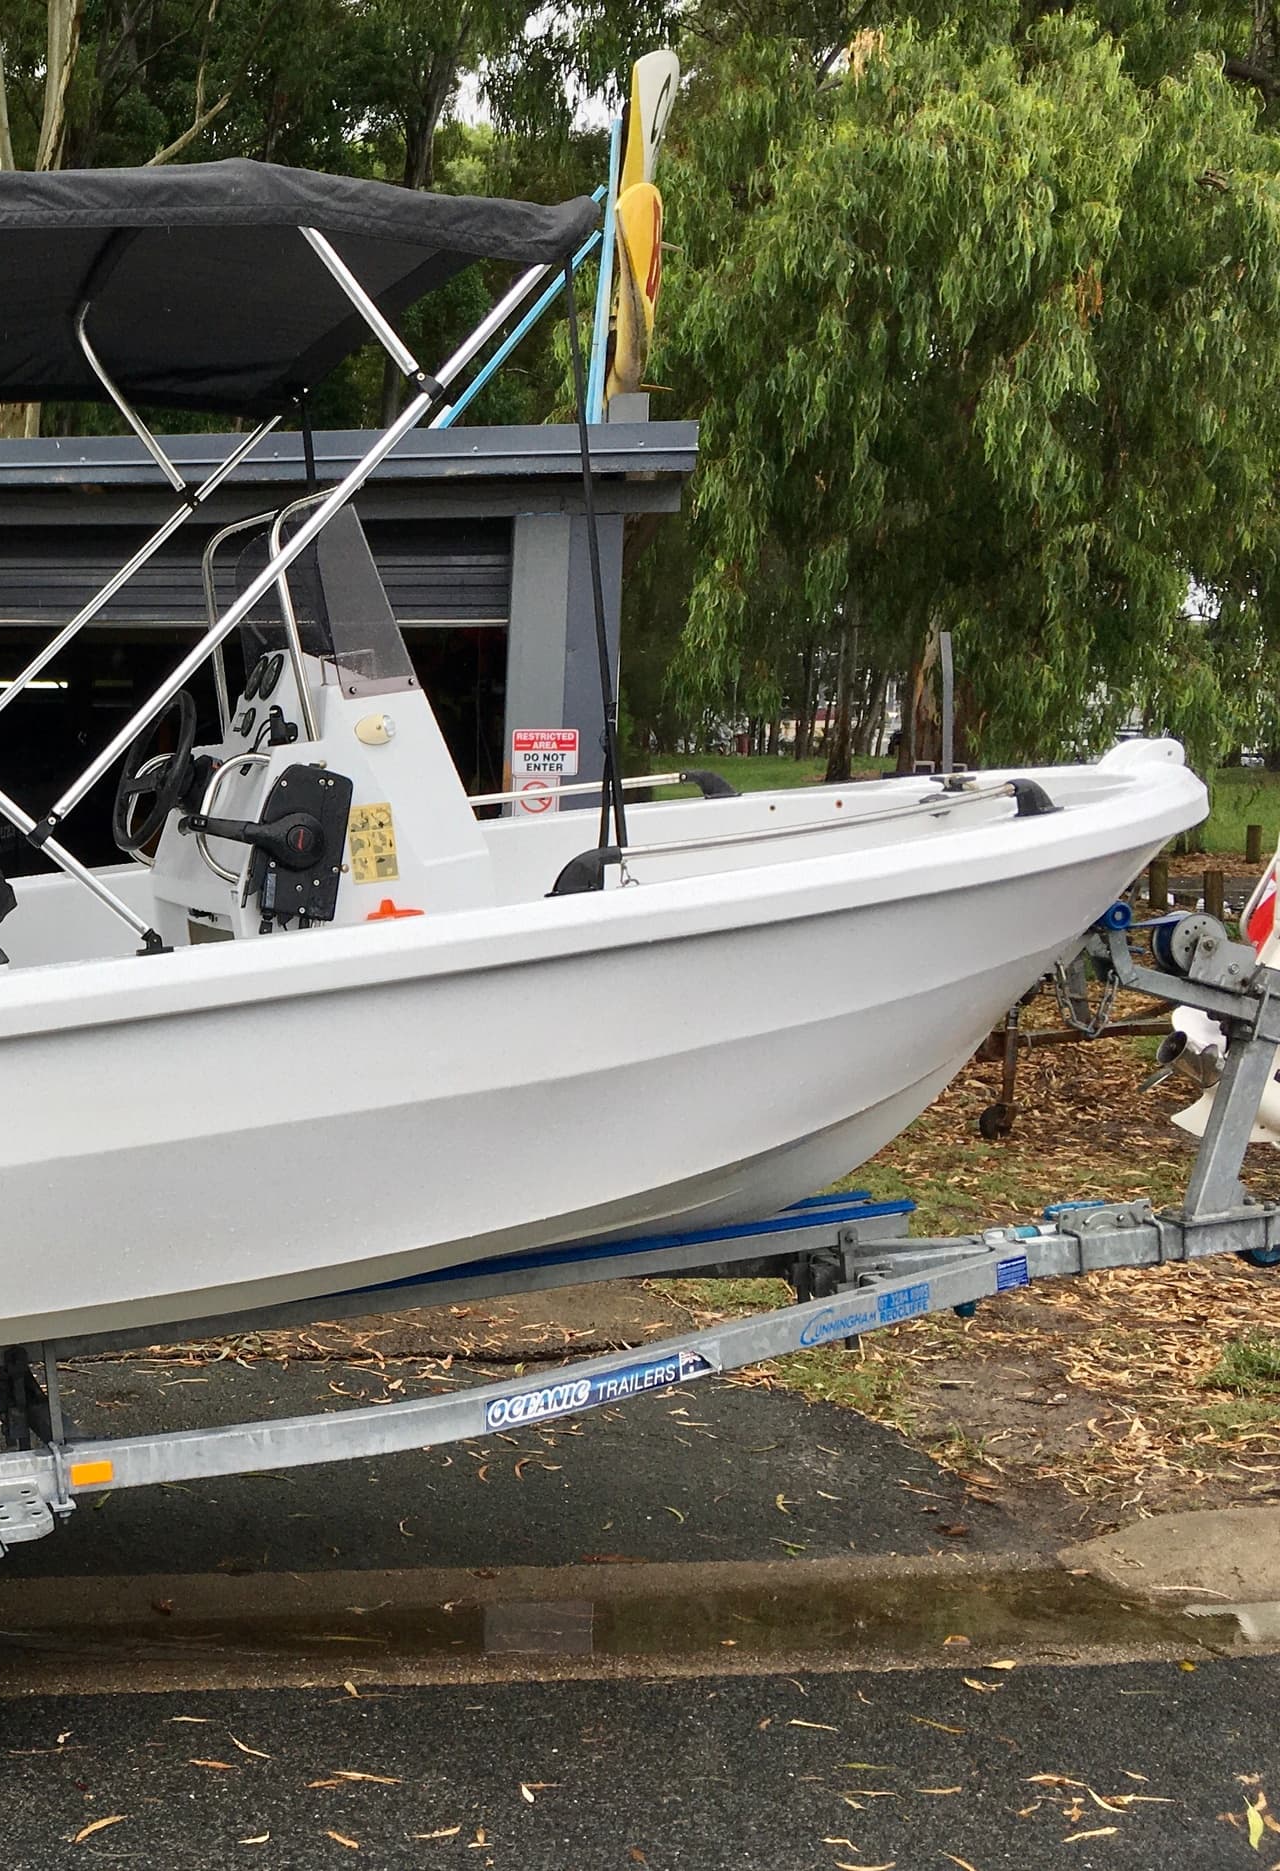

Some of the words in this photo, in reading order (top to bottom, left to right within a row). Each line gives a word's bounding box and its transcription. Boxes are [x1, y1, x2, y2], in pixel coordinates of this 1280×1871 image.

[516, 732, 574, 741] RESTRICTED
[532, 741, 558, 750] AREA
[523, 753, 539, 761] DO
[543, 753, 566, 761] NOT
[526, 763, 563, 771] ENTER
[880, 1299, 928, 1323] REDCLIFFE
[488, 1379, 592, 1427] OCEANIC
[597, 1363, 675, 1400] TRAILERS
